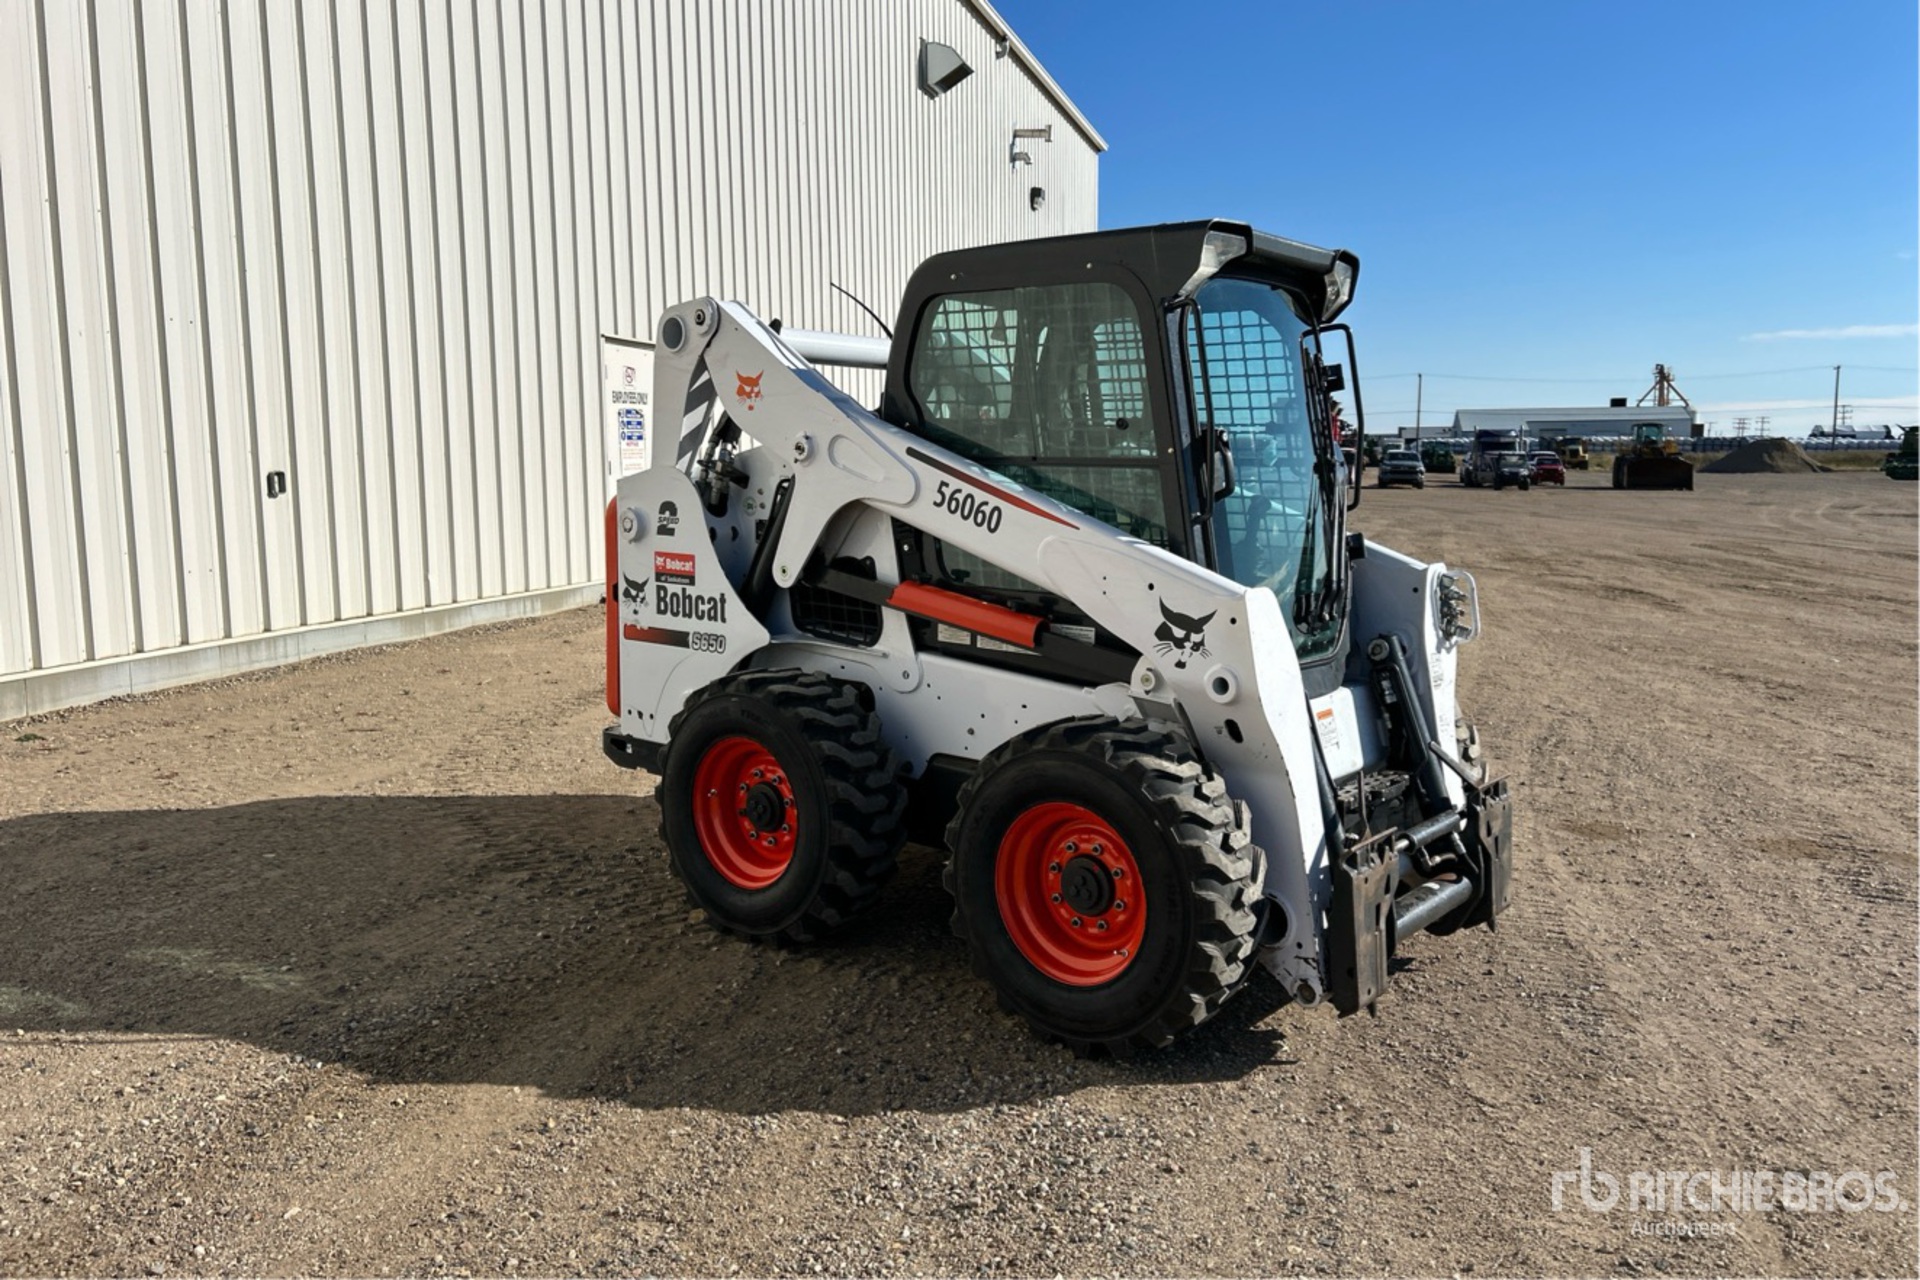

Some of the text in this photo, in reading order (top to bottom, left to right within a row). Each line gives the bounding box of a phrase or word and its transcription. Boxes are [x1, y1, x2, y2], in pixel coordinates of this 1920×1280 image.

[933, 480, 1002, 534] 56060
[657, 516, 680, 525] SPEED
[665, 558, 694, 572] Bobcat
[656, 585, 727, 624] Bobcat
[691, 631, 727, 654] S650
